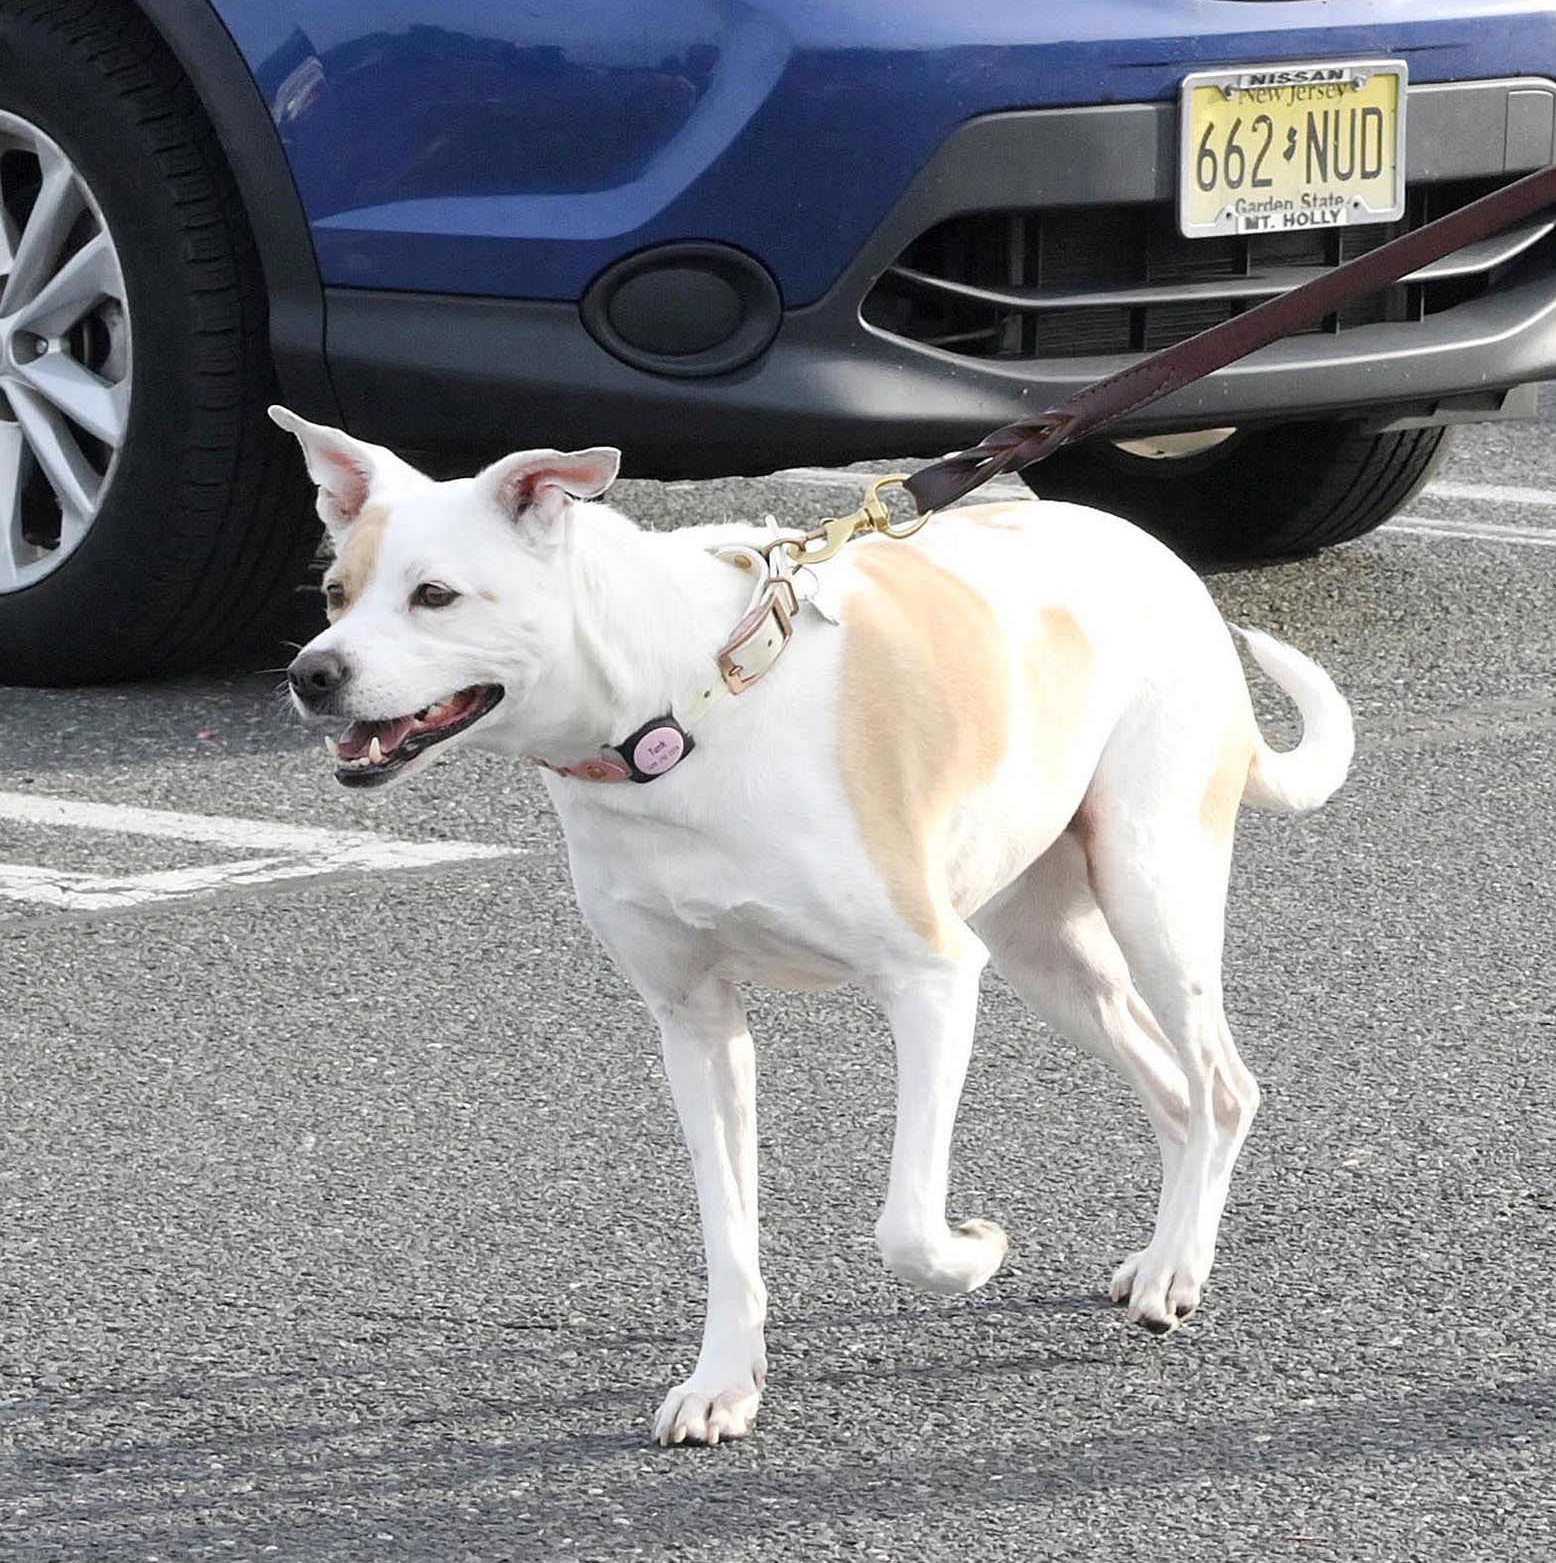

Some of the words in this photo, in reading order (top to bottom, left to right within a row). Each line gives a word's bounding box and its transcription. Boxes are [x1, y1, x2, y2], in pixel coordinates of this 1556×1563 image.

[1250, 69, 1345, 86] NISSAN
[1238, 85, 1281, 104] New
[1286, 82, 1348, 107] Jersey
[1196, 114, 1273, 192] 662
[1305, 106, 1383, 184] NUD
[1235, 196, 1293, 214] Garden
[1301, 192, 1344, 209] State
[1244, 215, 1276, 230] MT.
[1283, 209, 1341, 227] HOLLY
